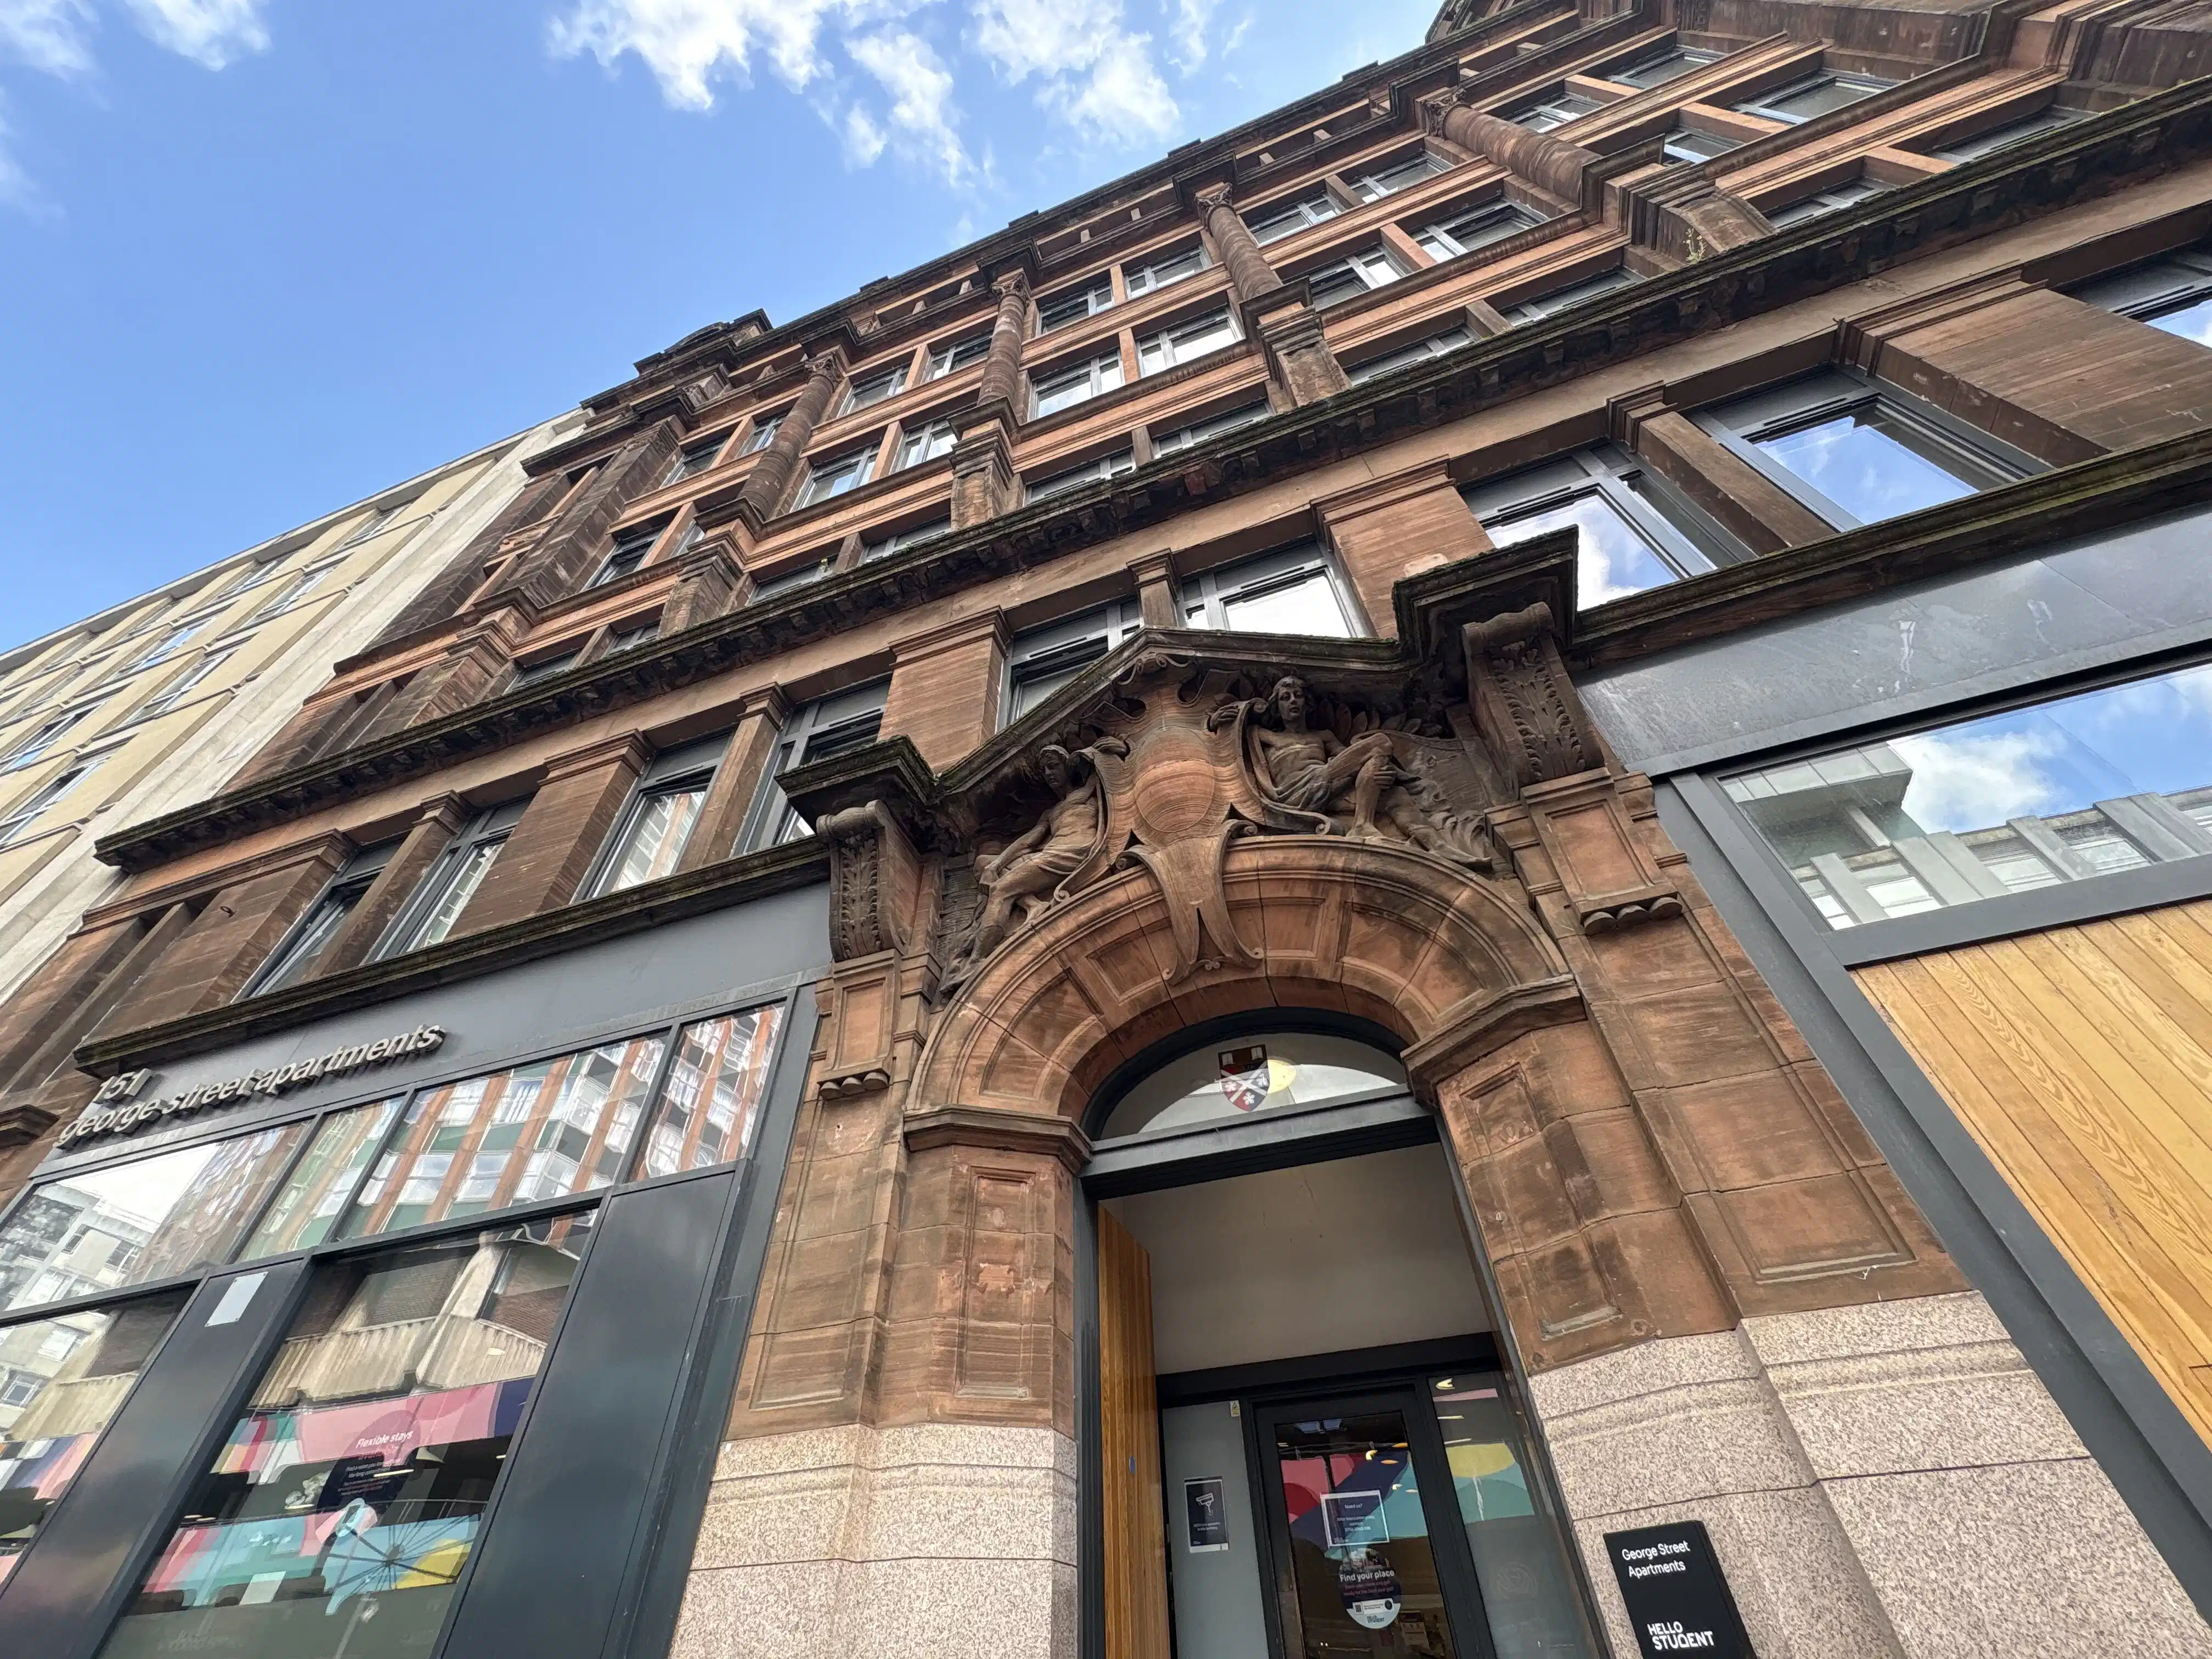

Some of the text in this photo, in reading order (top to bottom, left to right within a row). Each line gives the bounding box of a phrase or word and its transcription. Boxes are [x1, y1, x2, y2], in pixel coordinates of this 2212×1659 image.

[53, 1024, 443, 1147] george street apartments
[92, 1068, 149, 1103] 151
[356, 1430, 414, 1449] Flexible stays
[1622, 1540, 1691, 1561] George Street
[1339, 1570, 1395, 1582] Find your place
[1628, 1559, 1686, 1579] Apartments
[1647, 1621, 1683, 1636] HELLO
[1652, 1631, 1714, 1651] STUDENT
